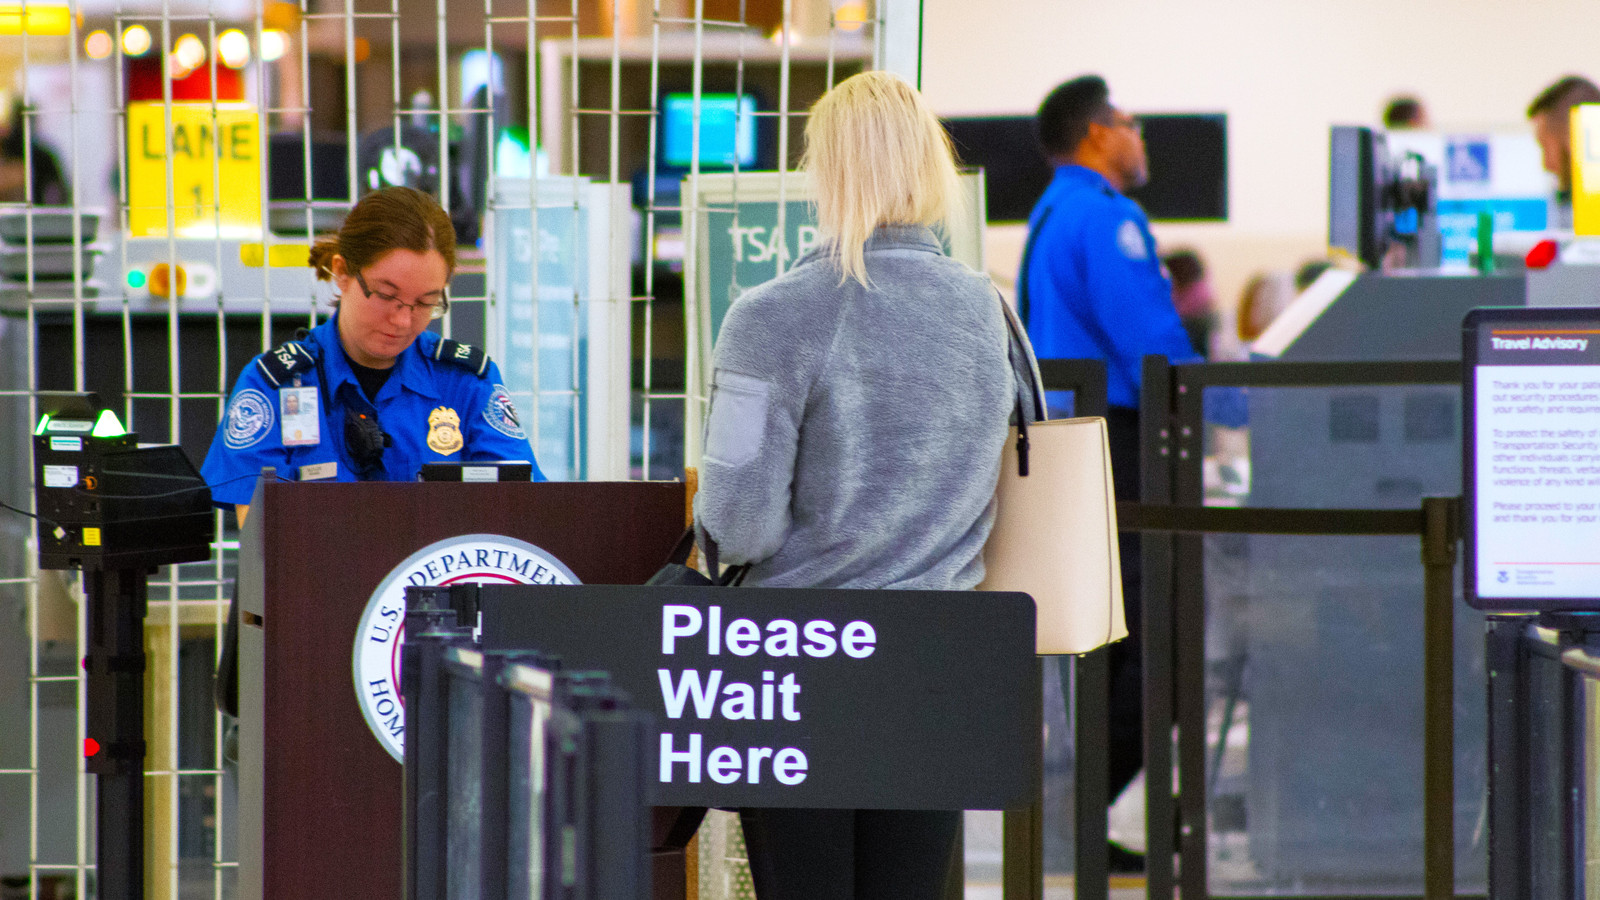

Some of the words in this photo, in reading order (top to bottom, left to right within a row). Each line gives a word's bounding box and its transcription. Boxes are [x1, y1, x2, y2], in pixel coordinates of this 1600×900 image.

[142, 123, 252, 160] LANE
[728, 225, 791, 262] TSA
[454, 343, 472, 359] TSA
[1491, 336, 1531, 350] Travel
[1532, 336, 1588, 351] Advisory
[273, 346, 297, 370] TSA
[1493, 381, 1519, 389] Thank
[1524, 382, 1540, 390] you
[1542, 381, 1554, 389] for
[1559, 382, 1578, 390] your
[1511, 394, 1545, 402] security
[1517, 406, 1544, 414] safety
[1493, 429, 1504, 437] To
[1506, 430, 1538, 438] protect
[1558, 430, 1585, 438] safety
[1588, 429, 1597, 437] of
[1493, 441, 1560, 450] Transportation
[1562, 441, 1598, 450] Security
[1493, 502, 1522, 510] Please
[1525, 503, 1562, 511] proceed
[1576, 503, 1595, 511] your
[1513, 514, 1537, 522] thank
[1542, 515, 1558, 523] you
[1561, 514, 1572, 522] for
[1577, 515, 1596, 523] your
[370, 605, 402, 643] U.S.
[661, 604, 877, 659] Please
[657, 669, 801, 722] Wait
[659, 733, 809, 786] Here
